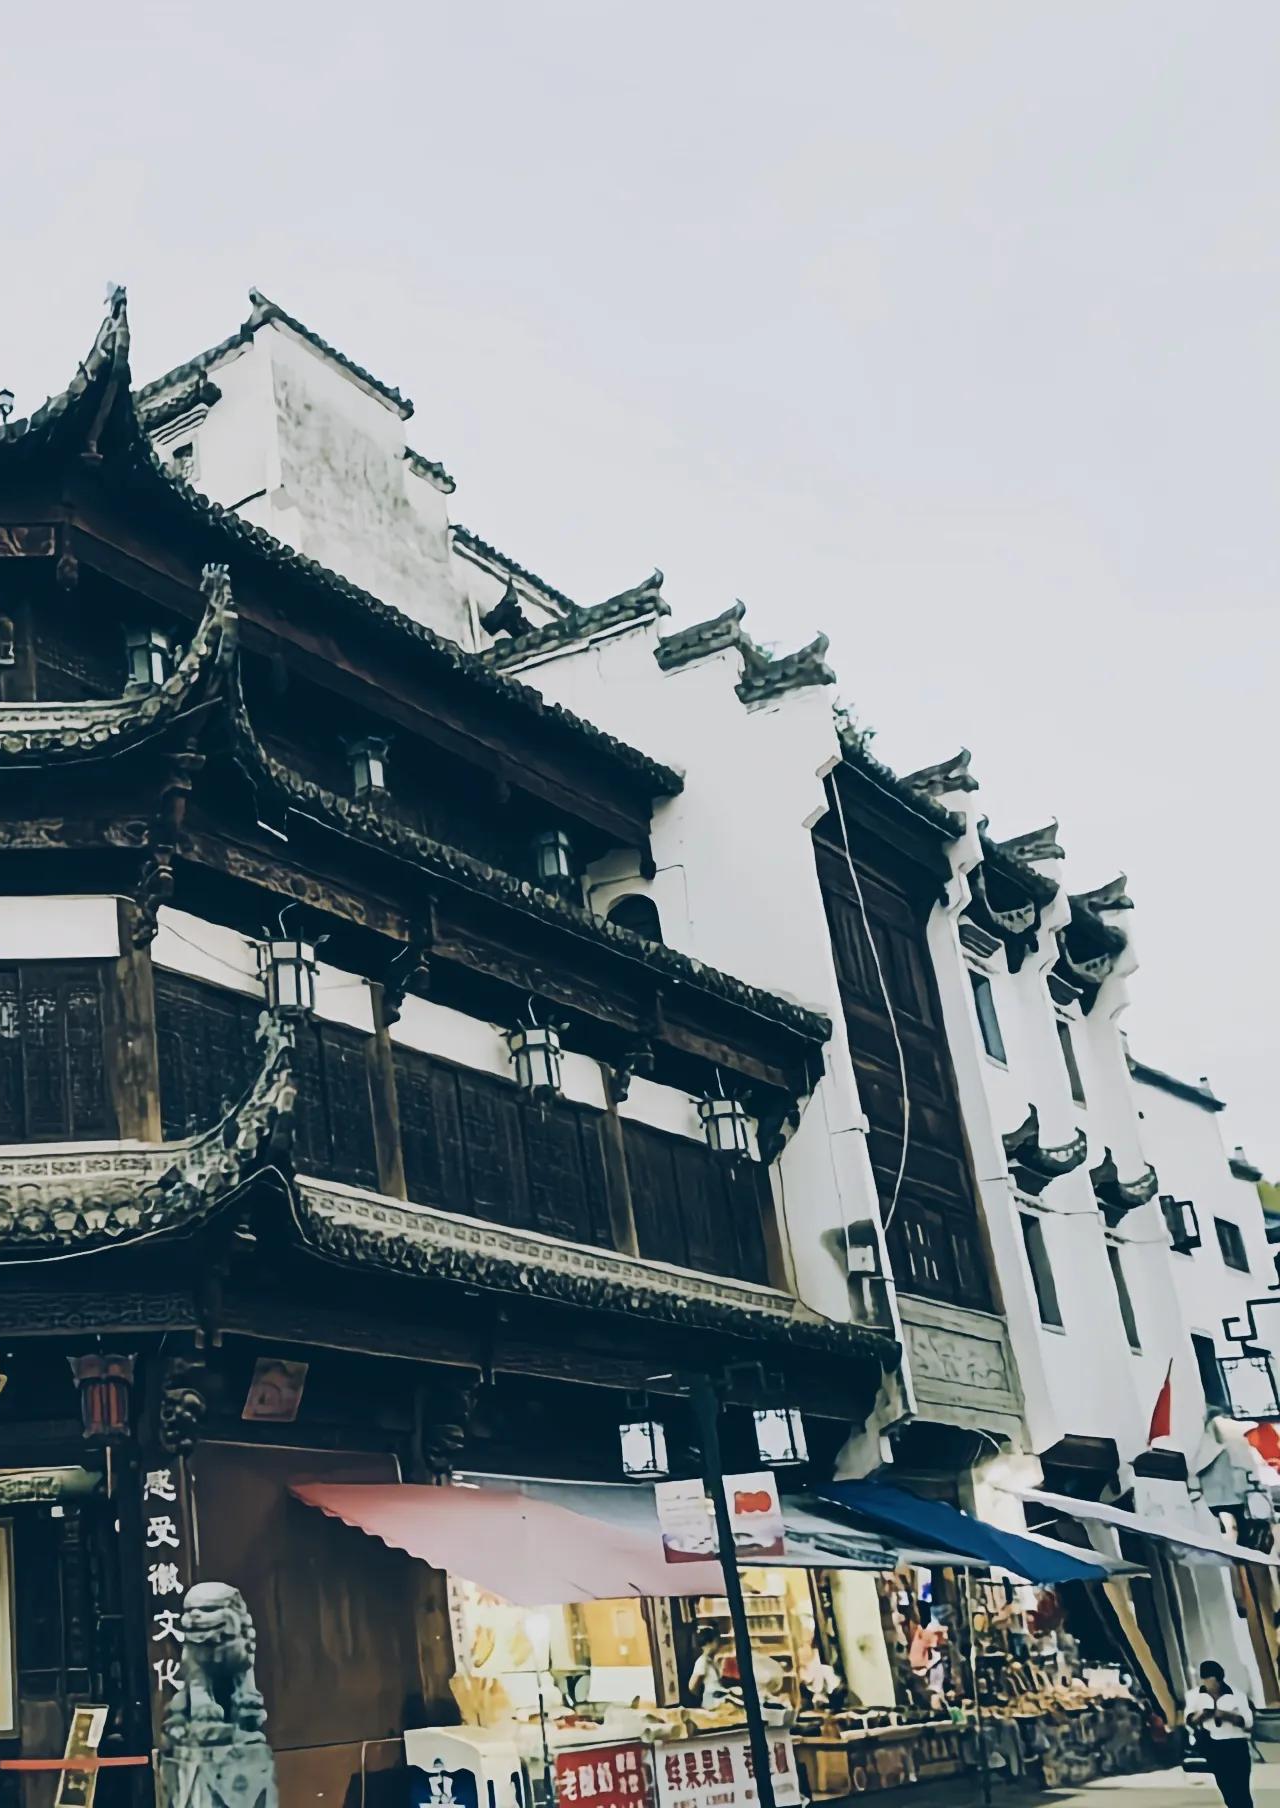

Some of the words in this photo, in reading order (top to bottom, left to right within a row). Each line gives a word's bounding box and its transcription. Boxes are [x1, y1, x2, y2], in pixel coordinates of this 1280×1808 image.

[142, 1468, 186, 1692] 感受徽文化
